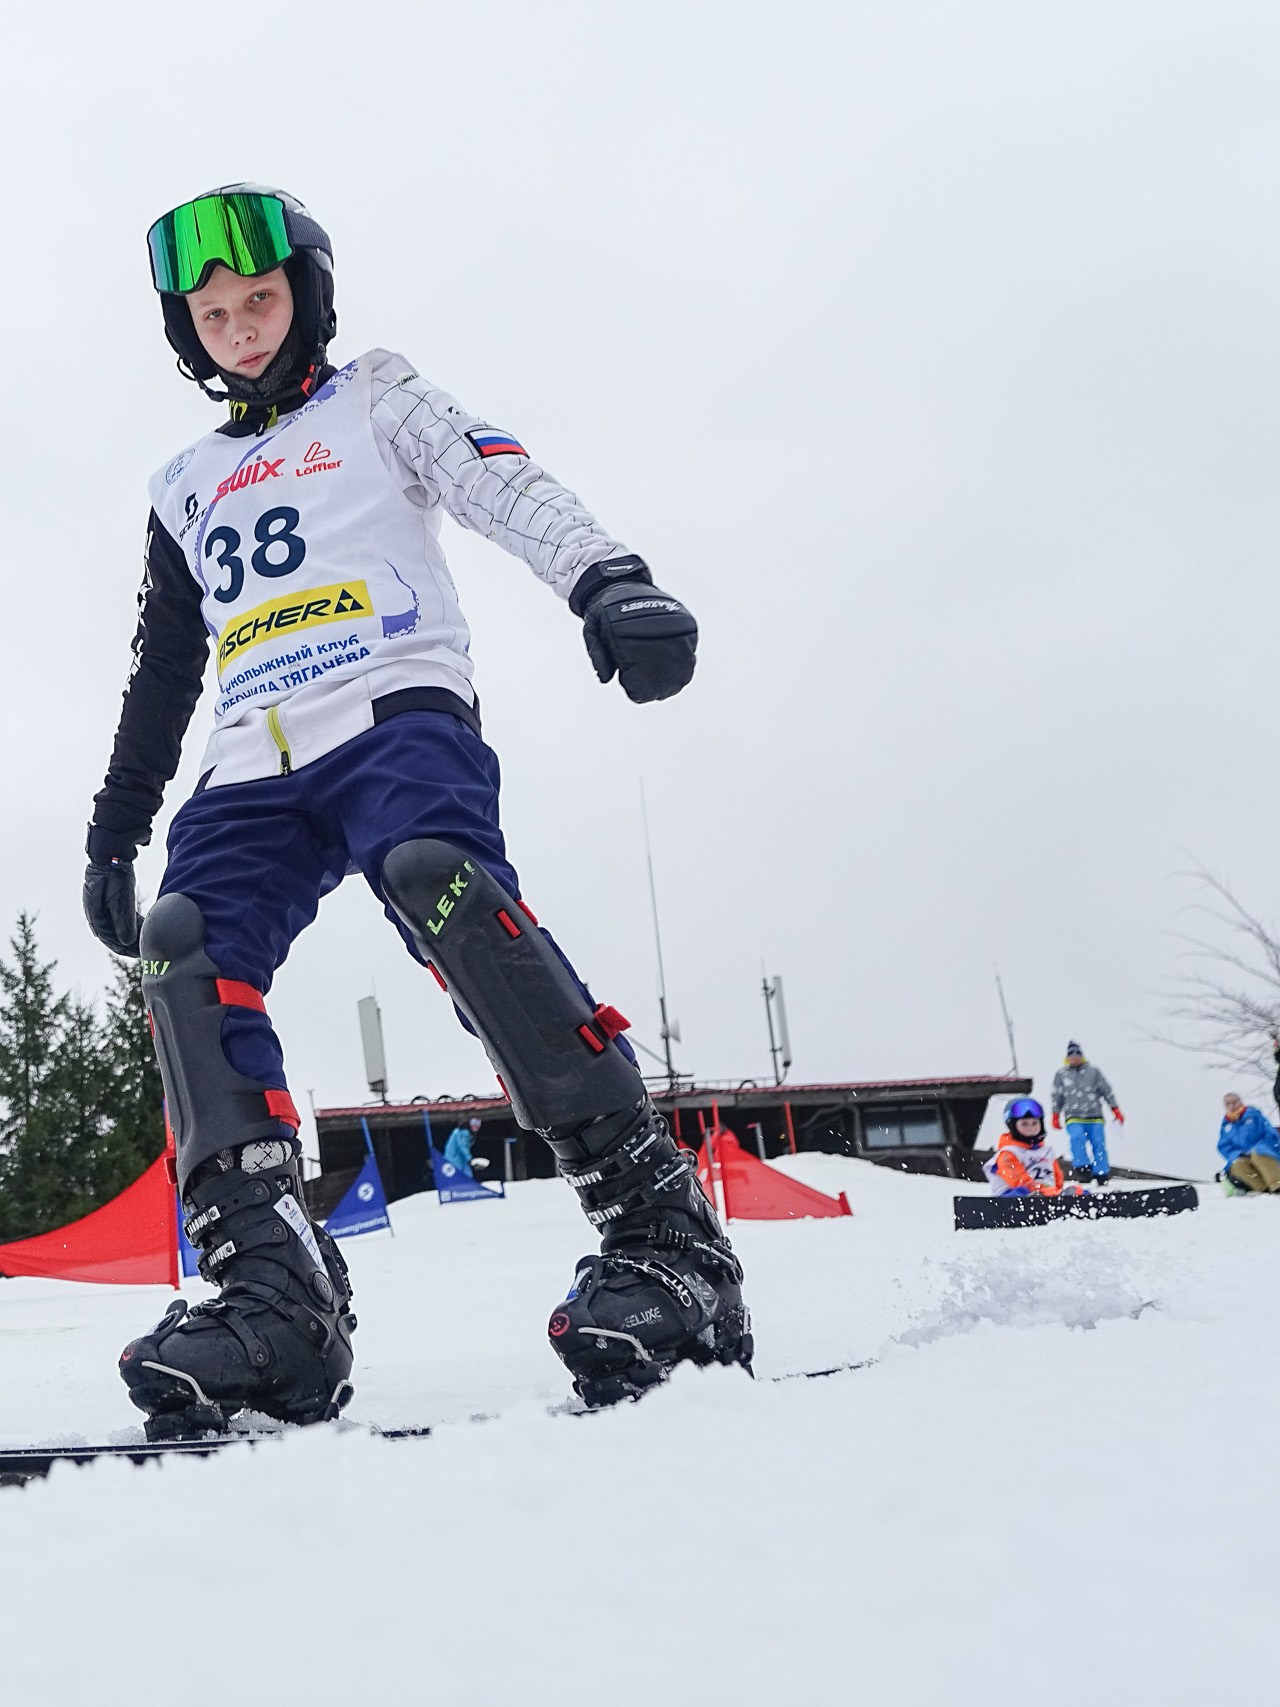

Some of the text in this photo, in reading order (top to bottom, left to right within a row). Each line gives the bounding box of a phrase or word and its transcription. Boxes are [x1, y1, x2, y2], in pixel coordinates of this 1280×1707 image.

[296, 460, 343, 477] Löffler
[205, 506, 306, 603] 38
[426, 860, 476, 936] LEKI
[143, 960, 171, 975] EKI
[623, 1306, 662, 1329] EELUXE
